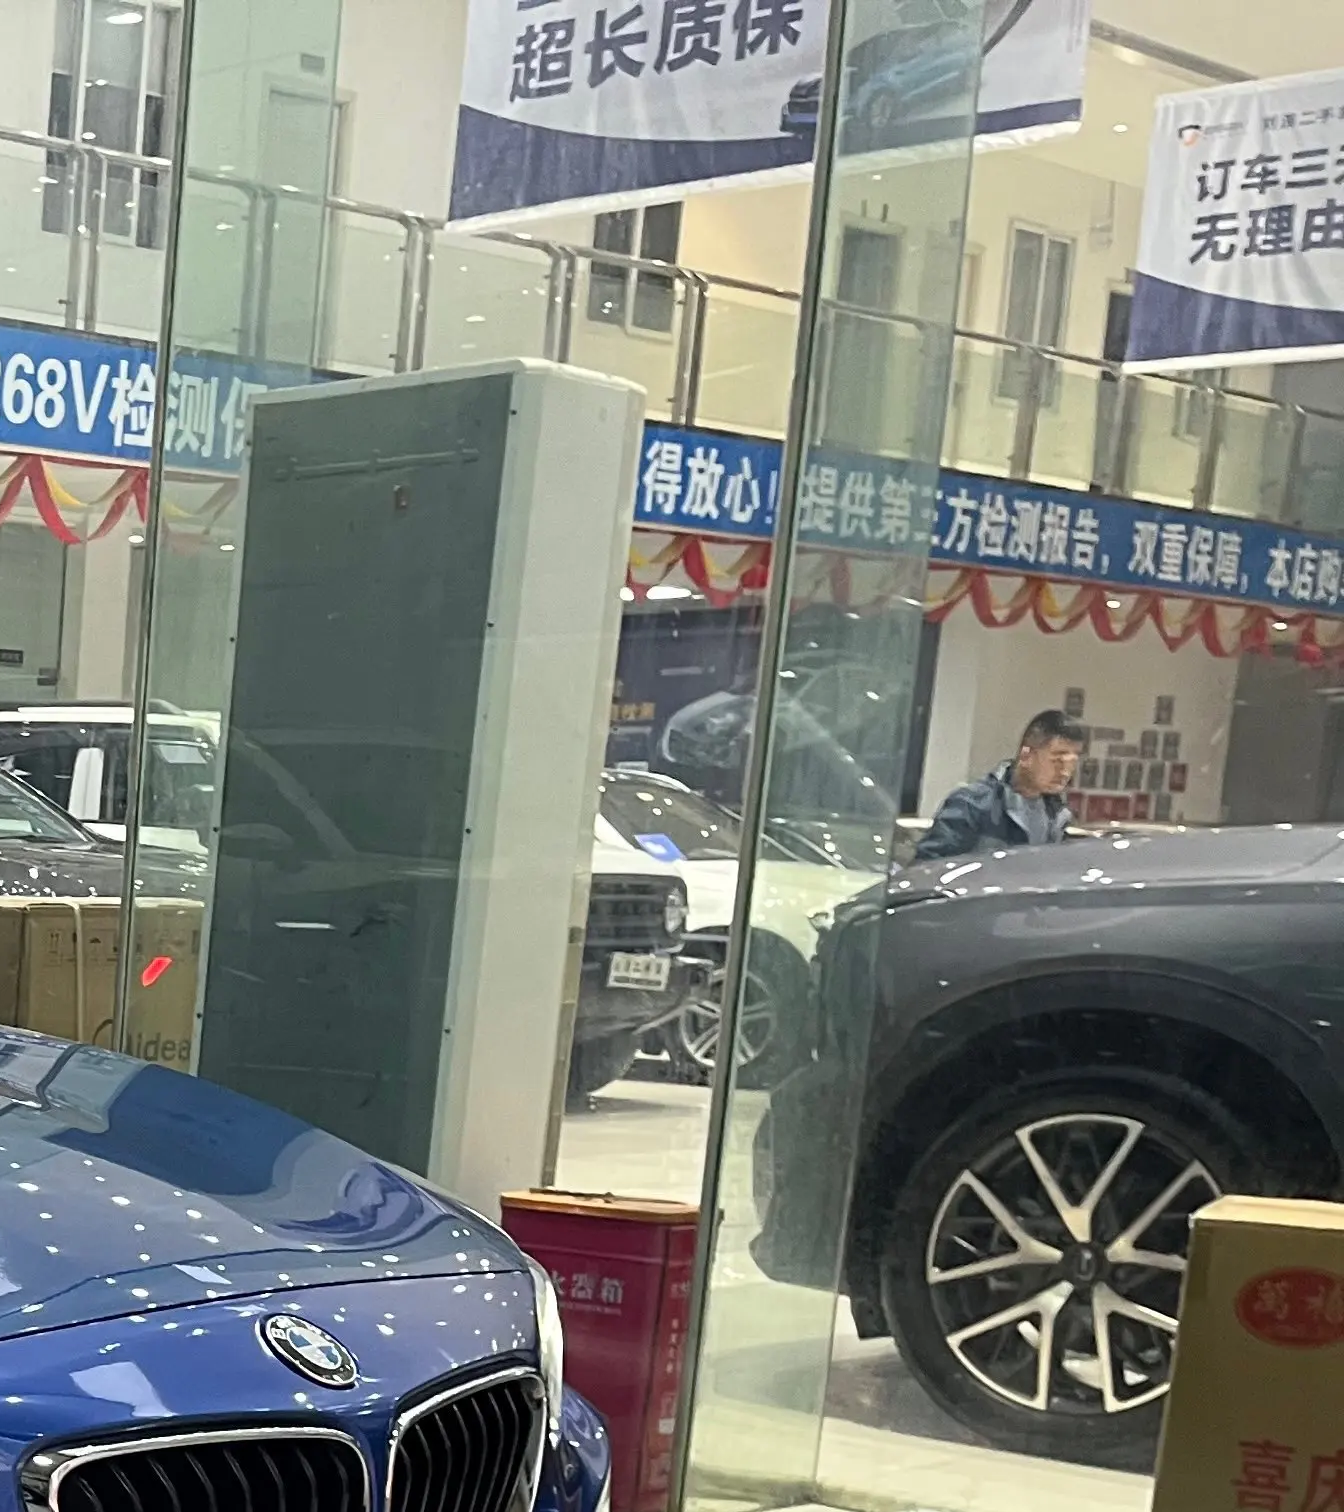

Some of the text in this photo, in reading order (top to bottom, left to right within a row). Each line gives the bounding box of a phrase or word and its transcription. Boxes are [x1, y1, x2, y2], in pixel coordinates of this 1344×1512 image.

[509, 0, 804, 102] 超长质保
[1197, 143, 1344, 202] 订车三
[124, 1032, 192, 1061] idea
